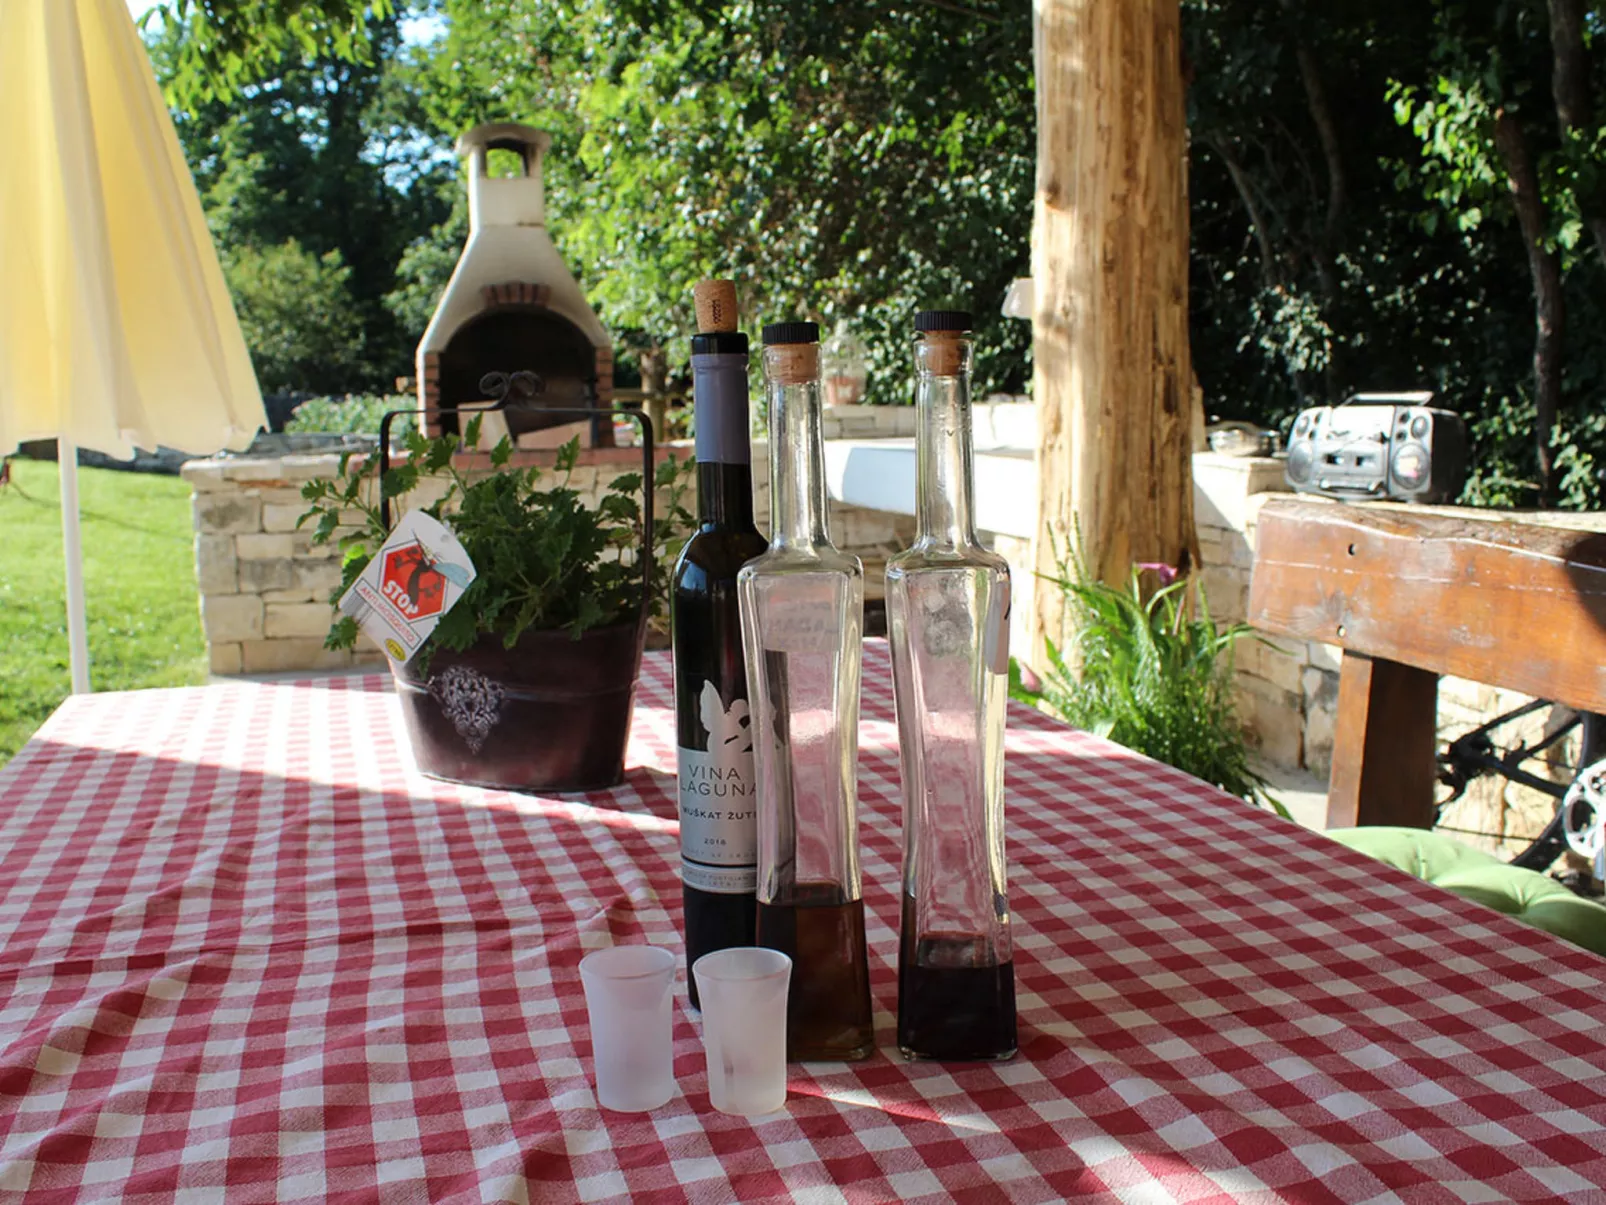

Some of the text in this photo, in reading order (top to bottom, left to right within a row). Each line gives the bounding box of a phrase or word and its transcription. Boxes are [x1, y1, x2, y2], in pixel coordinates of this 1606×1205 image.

[384, 580, 418, 614] STOP
[688, 764, 741, 781] VINA
[681, 781, 756, 797] LAGUNA
